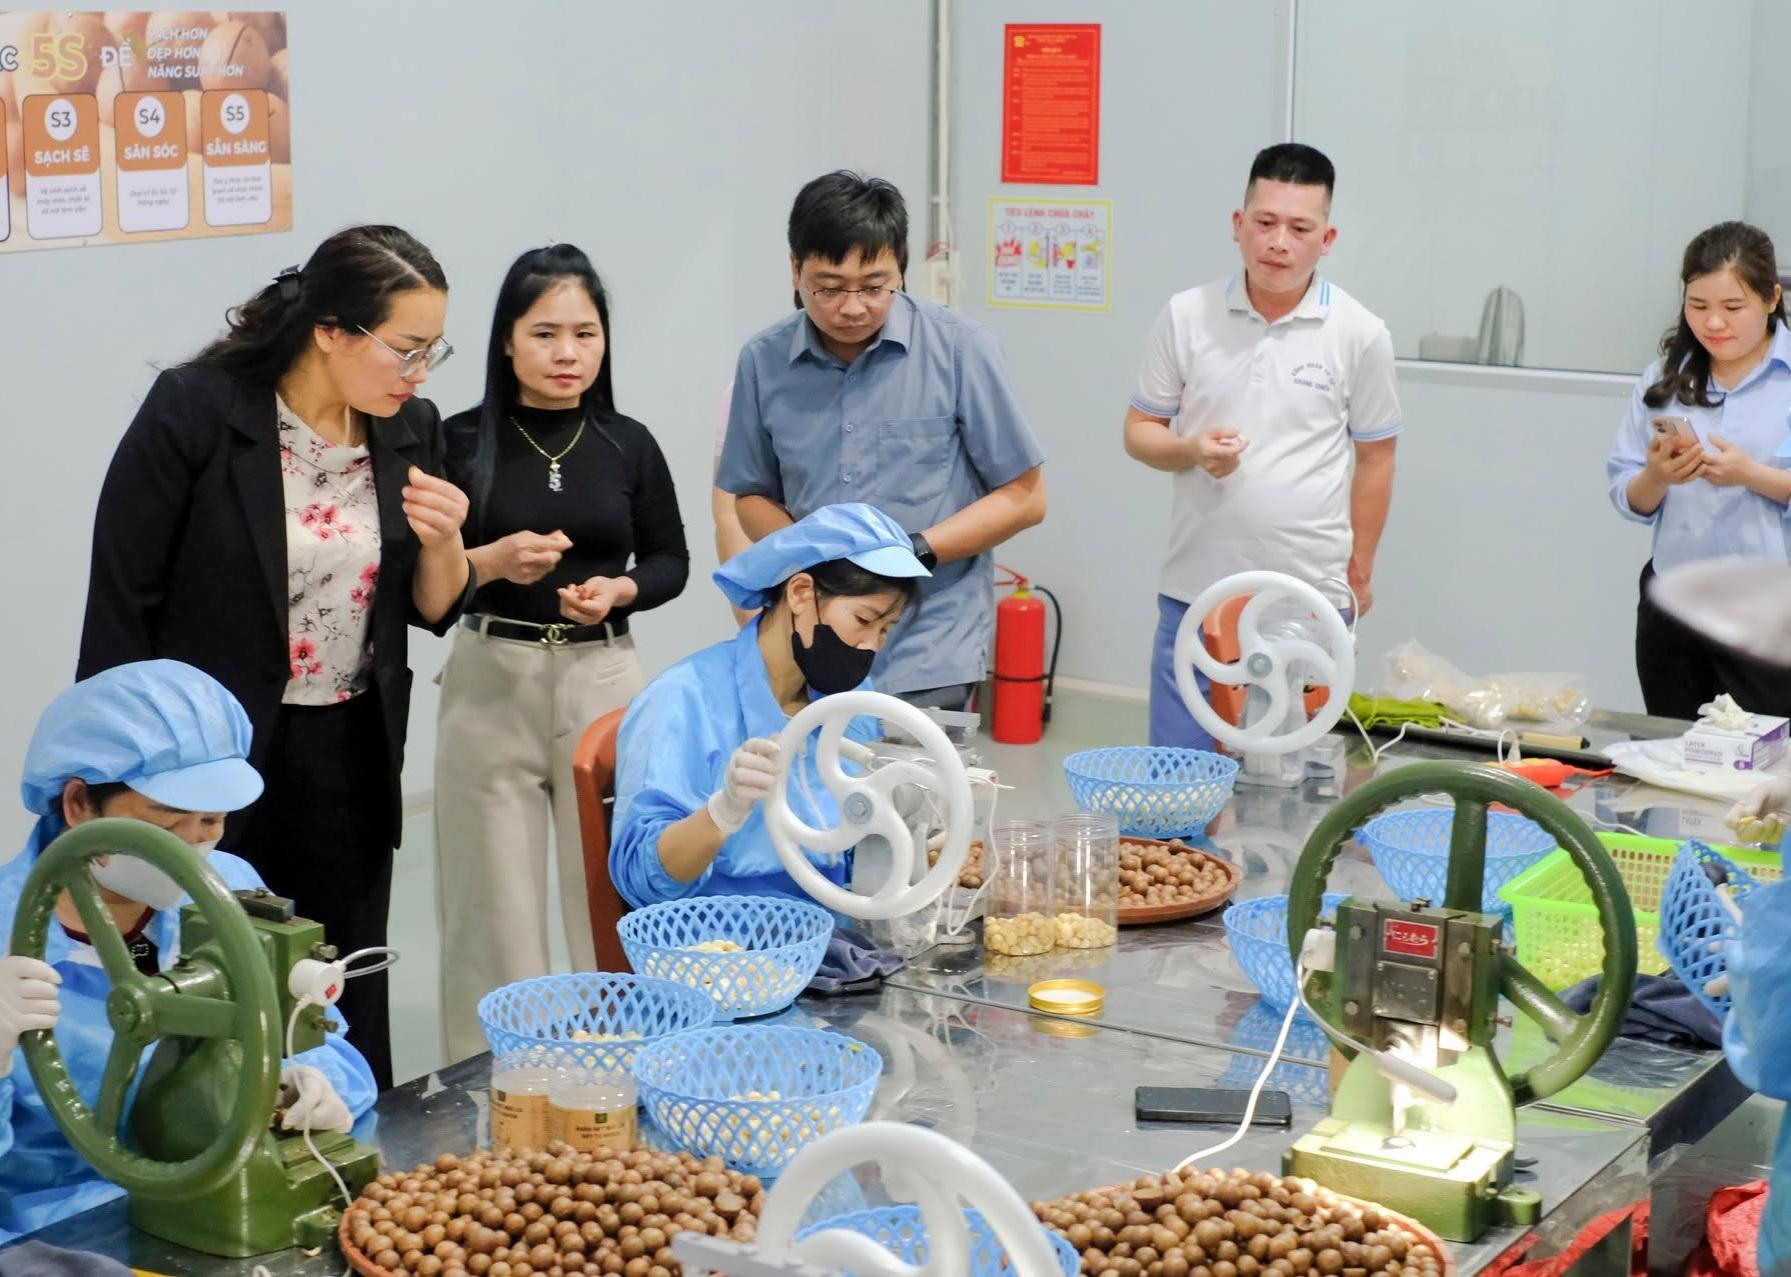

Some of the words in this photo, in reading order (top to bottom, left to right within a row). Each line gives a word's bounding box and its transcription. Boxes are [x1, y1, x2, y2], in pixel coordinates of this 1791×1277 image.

[0, 45, 19, 72] C
[32, 33, 88, 81] 5S
[99, 38, 133, 68] ĐỂ
[148, 63, 182, 78] NĂNG
[51, 111, 71, 128] S3
[139, 108, 160, 124] S4
[226, 106, 245, 121] S5
[34, 150, 71, 167] SẠCH
